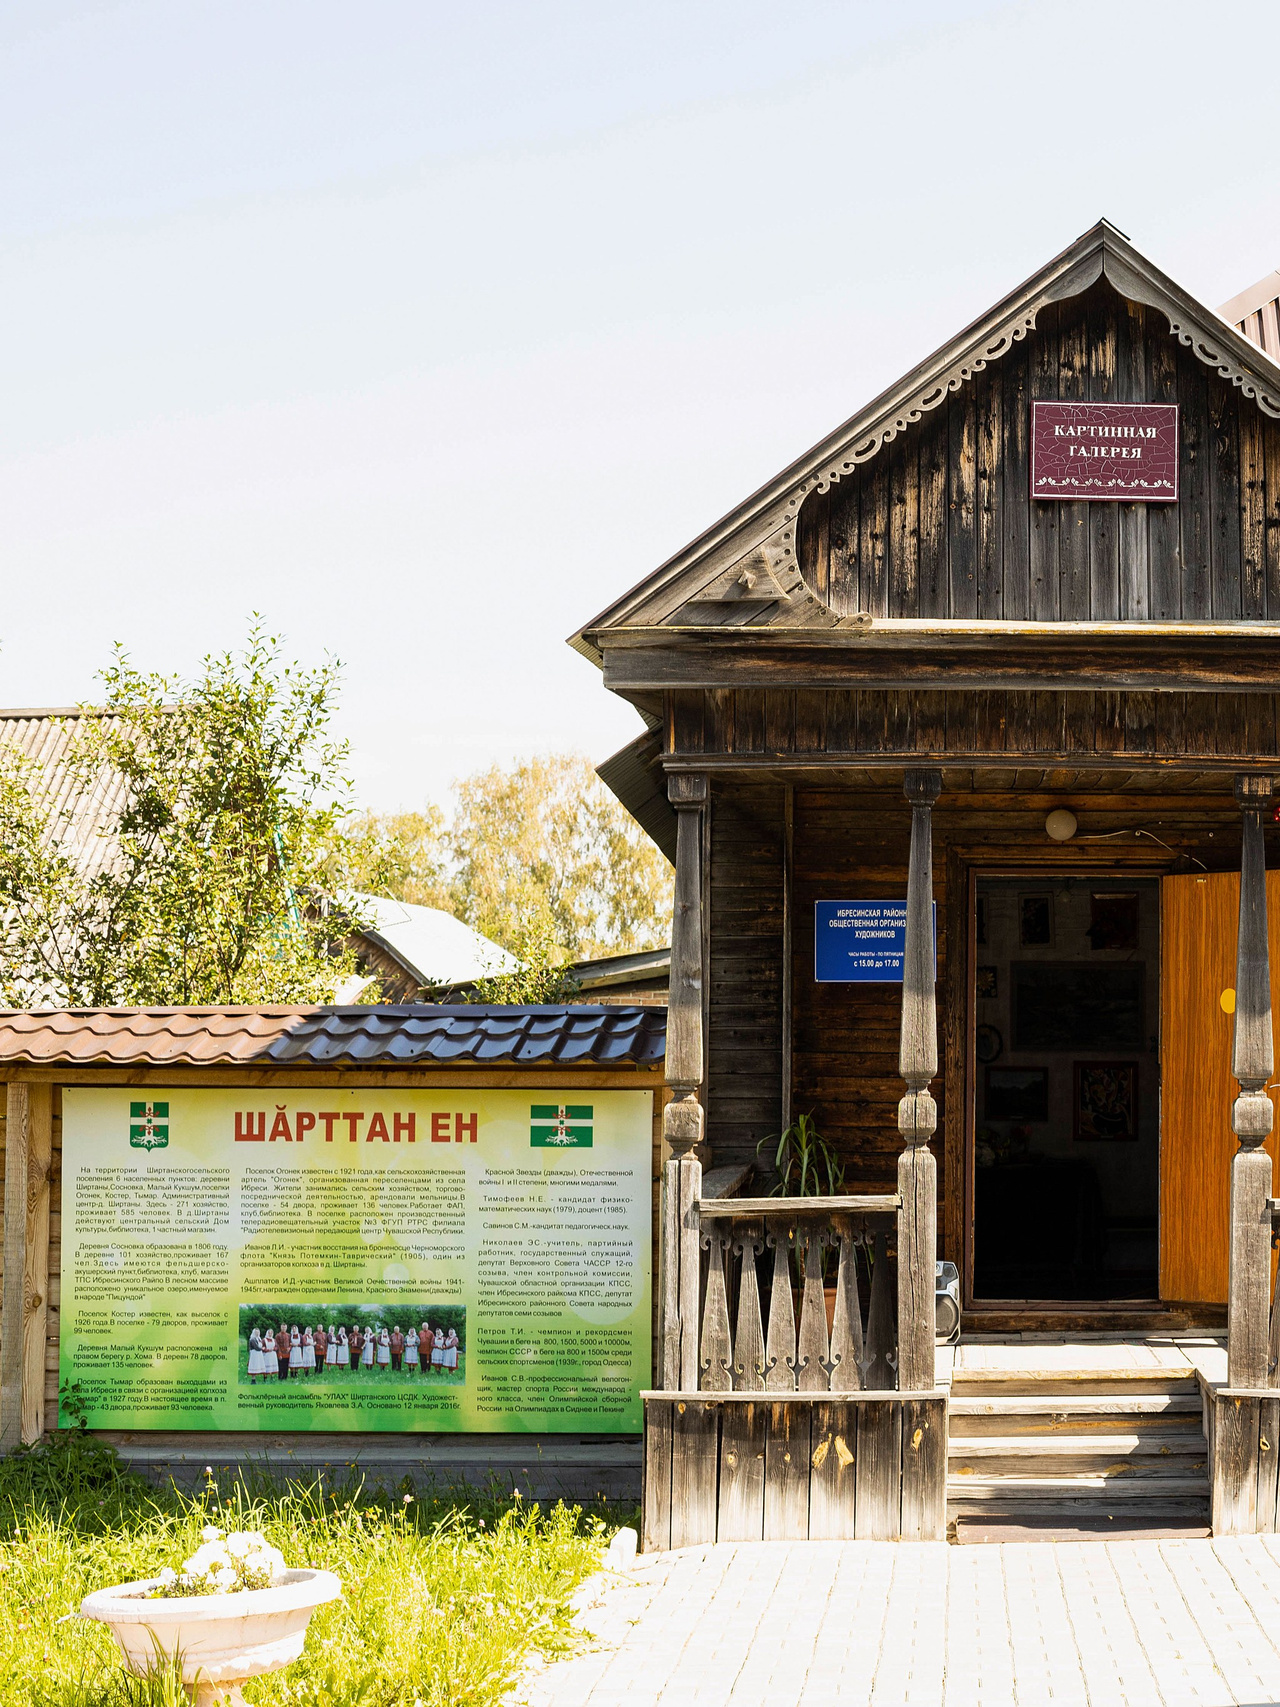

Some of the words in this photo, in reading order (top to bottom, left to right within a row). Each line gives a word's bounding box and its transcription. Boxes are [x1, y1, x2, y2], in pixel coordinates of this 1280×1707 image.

[1054, 425, 1157, 438] КАРТИННАЯ
[1069, 446, 1142, 459] ГАЛЕРЕЯ
[829, 919, 878, 928] ОБЩЕСТВЕННАЯ
[855, 931, 895, 939] ХУДОЖНИКОВ
[234, 1104, 416, 1142] ШӐРТТАН
[431, 1112, 478, 1142] ЕН
[350, 1393, 396, 1402] Ширтанского
